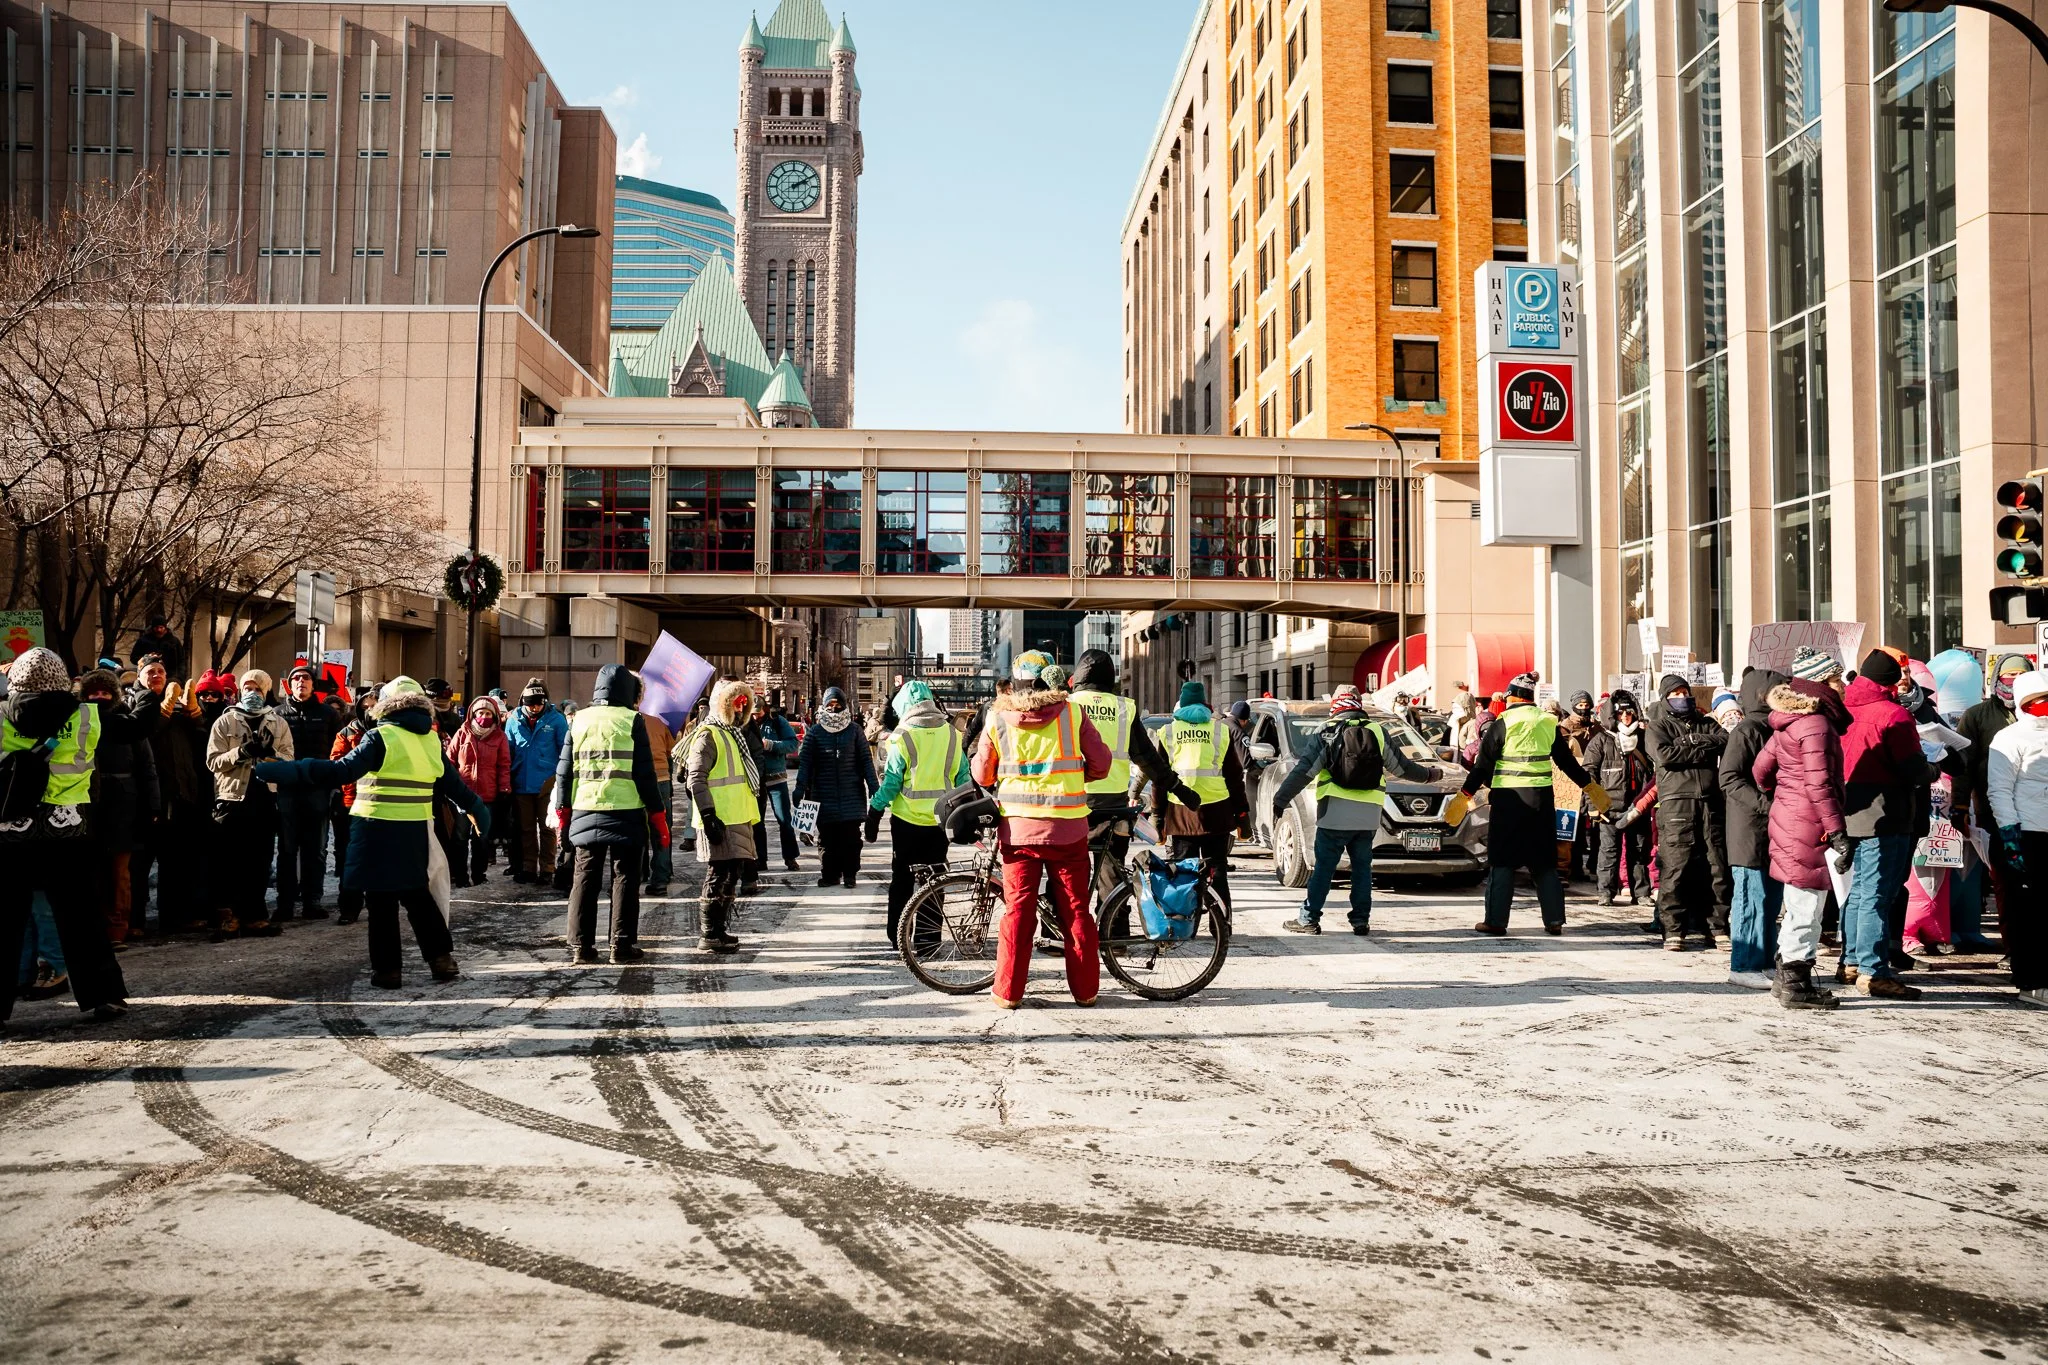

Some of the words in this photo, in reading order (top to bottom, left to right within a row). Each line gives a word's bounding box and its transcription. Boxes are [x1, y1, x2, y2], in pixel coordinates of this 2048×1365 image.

[1525, 280, 1543, 304] P
[1491, 278, 1503, 335] HAAF
[1561, 281, 1574, 338] RAMP
[1516, 313, 1551, 323] PUBLIC
[1513, 322, 1555, 333] PARKING
[1513, 390, 1533, 410] Bar
[1542, 391, 1560, 411] Zia
[1749, 623, 1797, 653] REST
[1799, 623, 1819, 647] IN
[1176, 730, 1211, 740] UNION
[1426, 837, 1439, 847] 977
[1928, 840, 1948, 848] ICE
[1930, 848, 1949, 856] OUT
